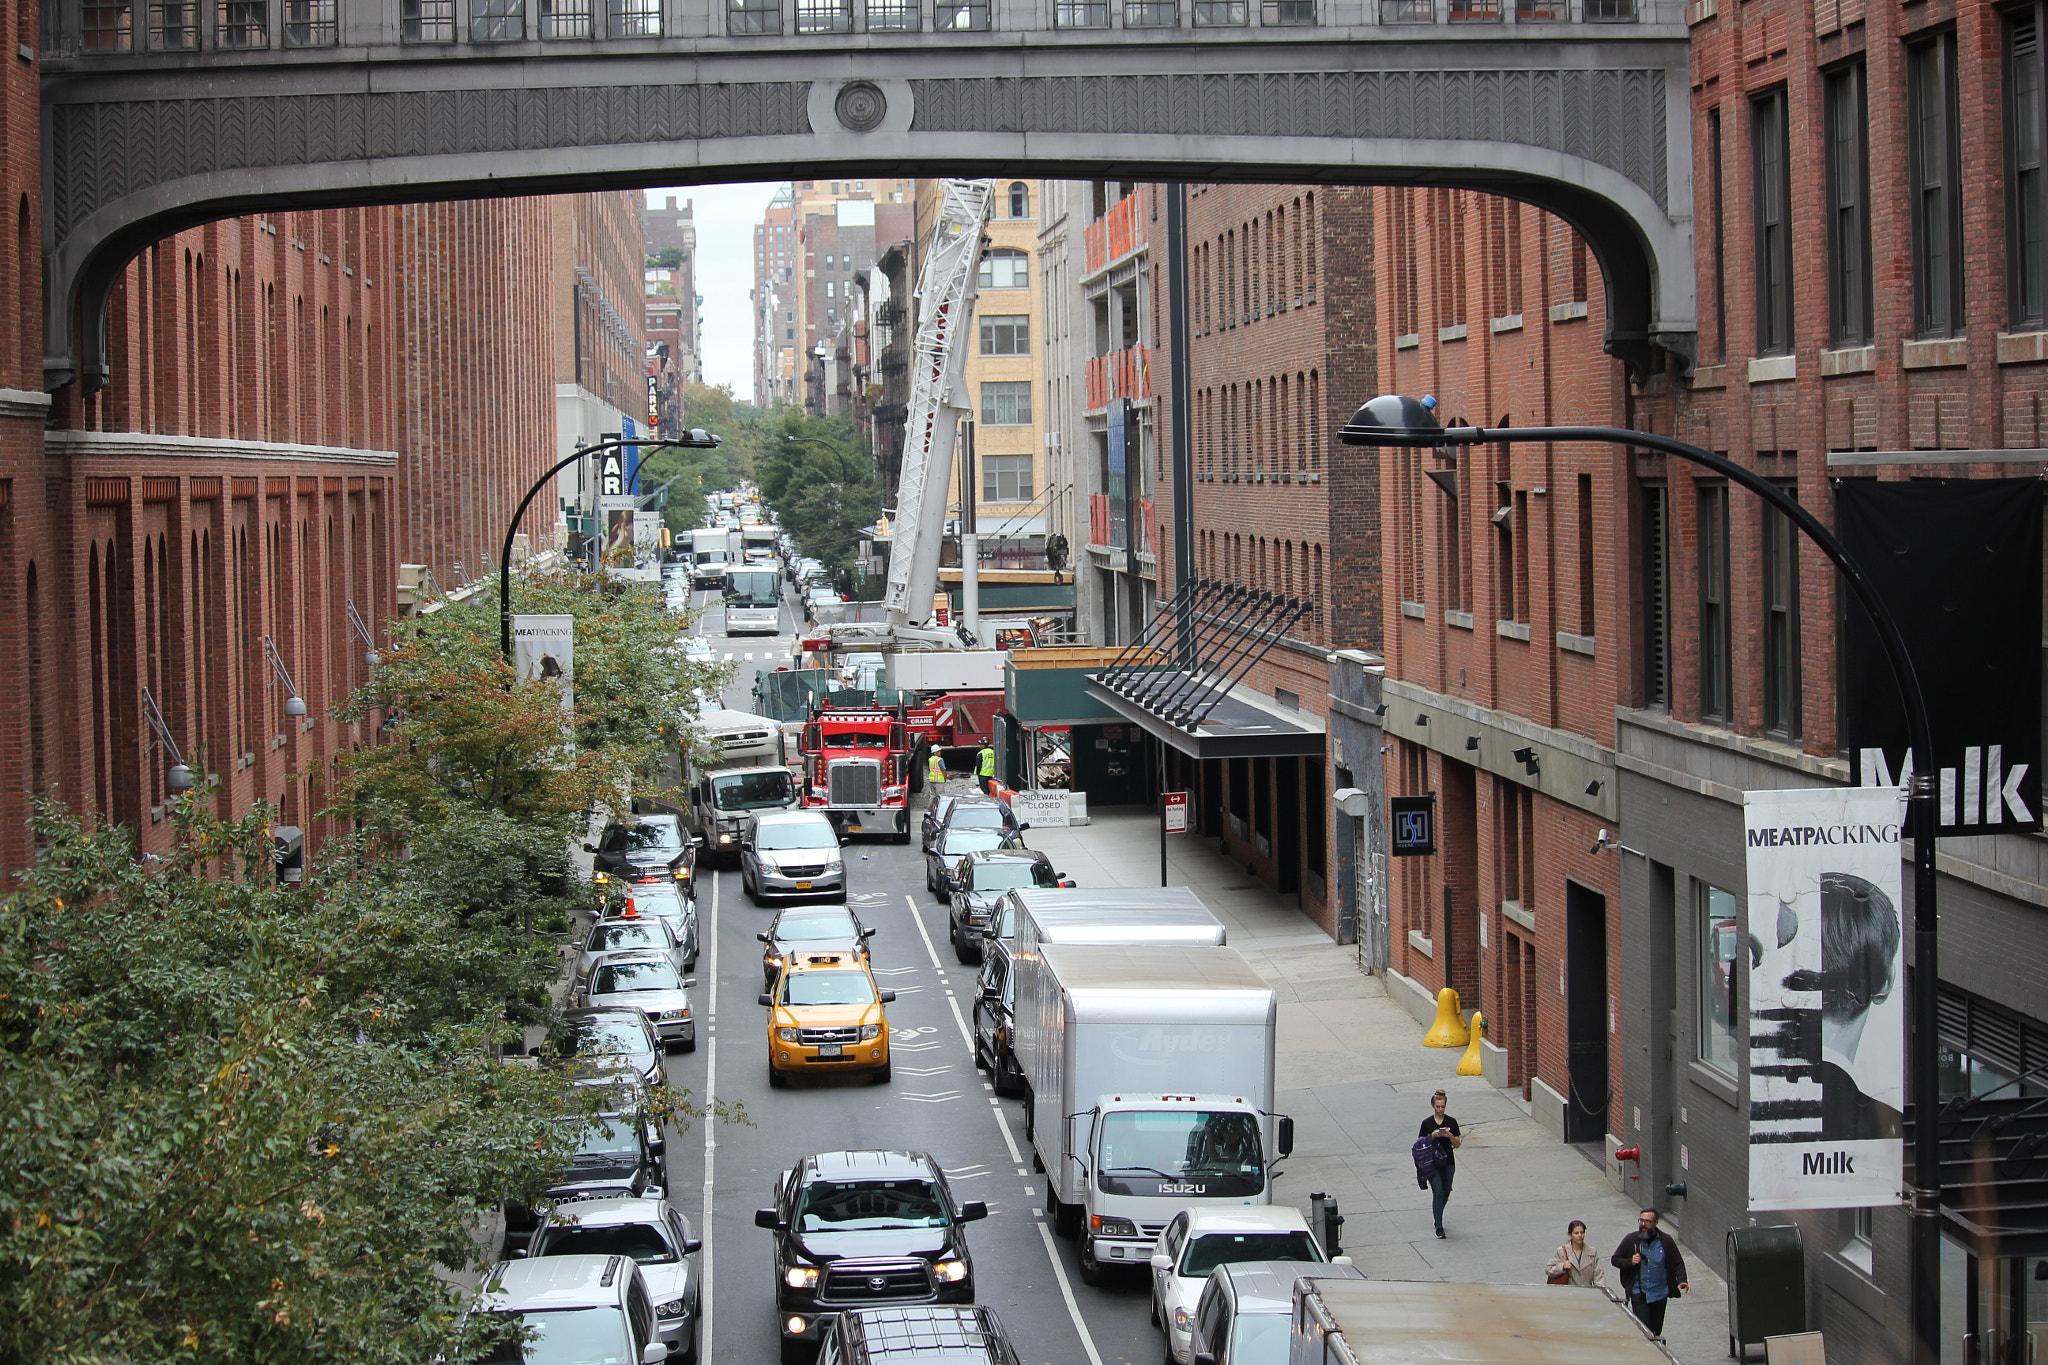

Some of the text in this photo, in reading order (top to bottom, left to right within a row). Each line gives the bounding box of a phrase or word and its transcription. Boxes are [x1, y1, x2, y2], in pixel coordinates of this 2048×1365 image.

[648, 377, 657, 413] PARK
[604, 438, 621, 495] PAR
[515, 628, 572, 636] MEATPACKING
[1023, 793, 1065, 801] SIDEWALK
[1748, 823, 1899, 847] MEATPACKING
[1137, 1028, 1232, 1057] Ryder
[1803, 1151, 1854, 1175] Milk
[1158, 1184, 1206, 1193] ISUZU
